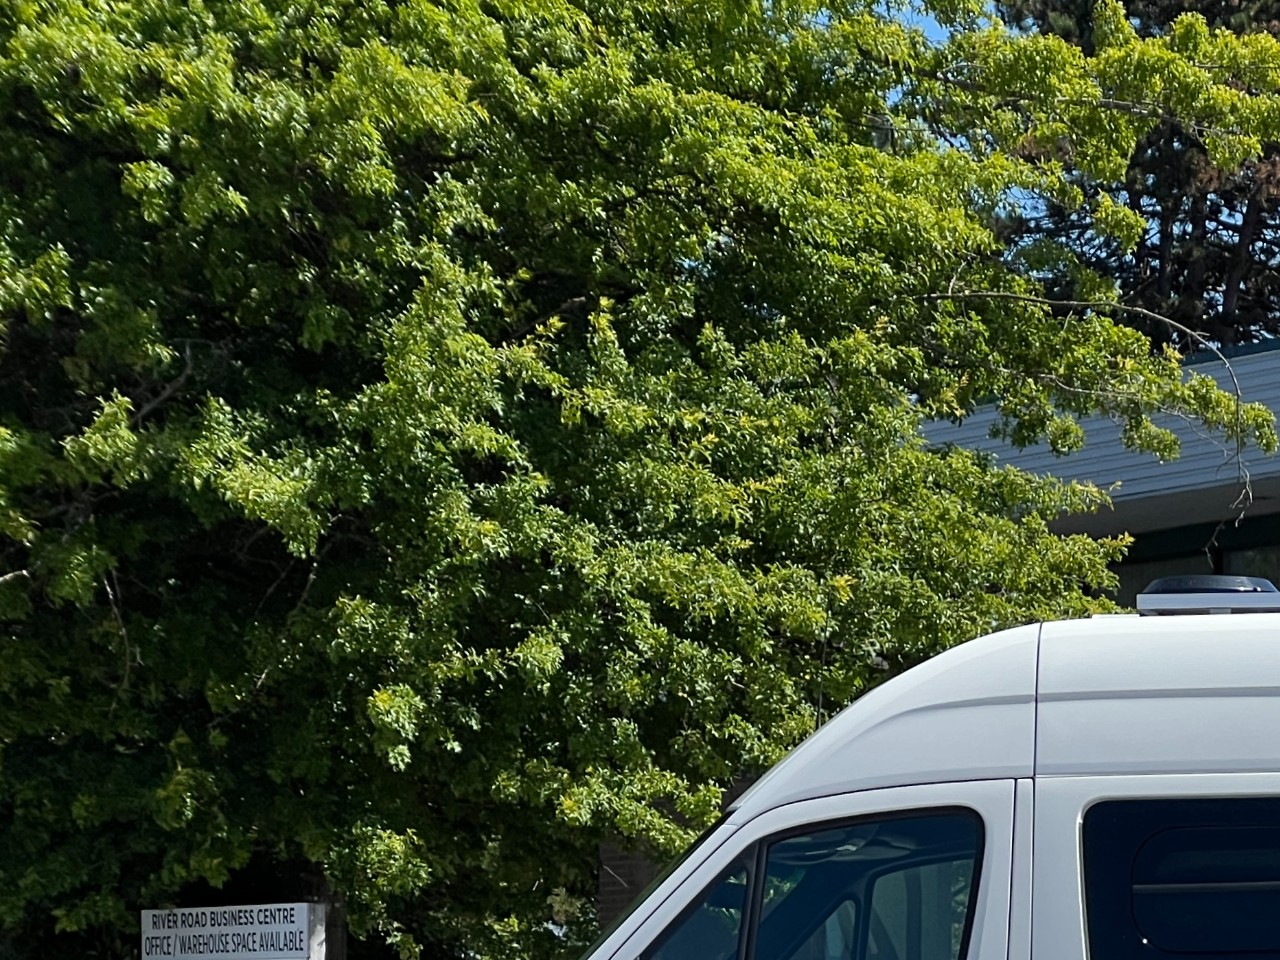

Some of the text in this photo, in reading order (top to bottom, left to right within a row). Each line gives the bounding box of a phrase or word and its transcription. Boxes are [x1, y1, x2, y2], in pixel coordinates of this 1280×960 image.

[152, 907, 295, 930] RIVER ROAD BUSINESS CENTRE
[144, 936, 171, 956] OFFICE
[179, 932, 230, 954] WAREHOUSE
[231, 931, 257, 953] SPACE
[259, 929, 304, 952] AVAILABLE
